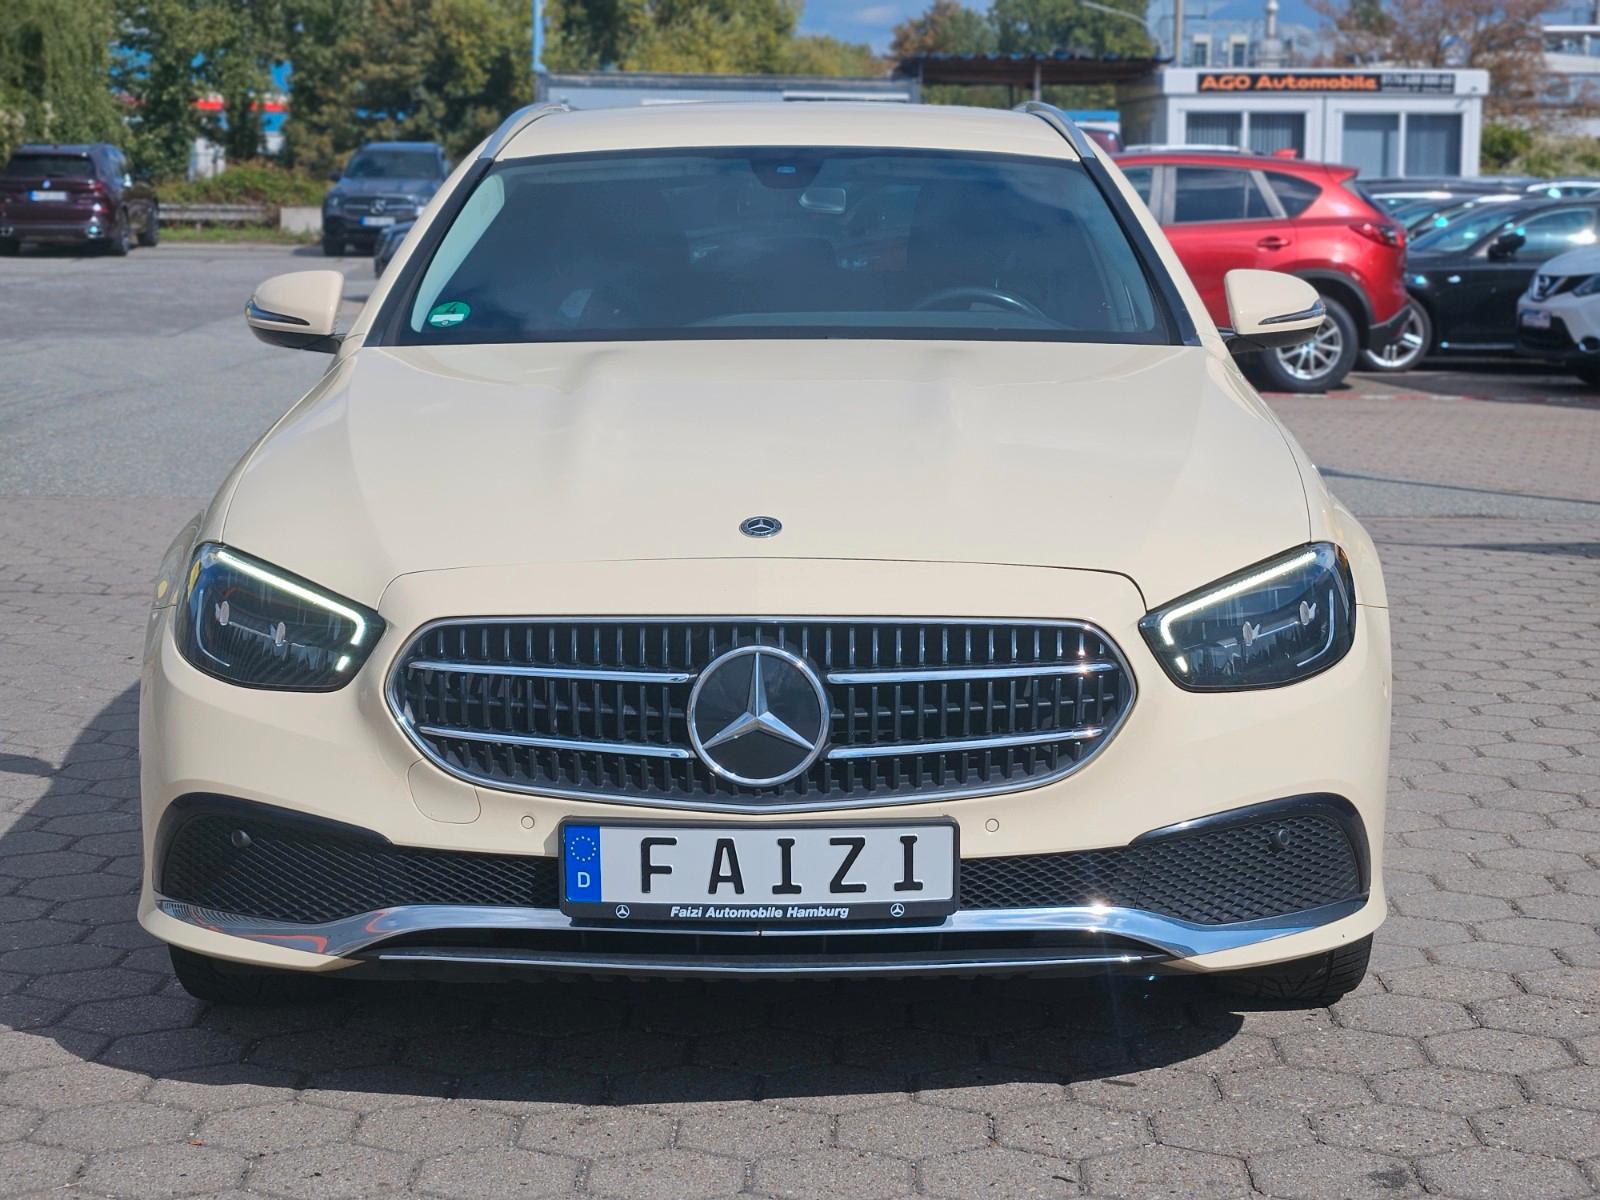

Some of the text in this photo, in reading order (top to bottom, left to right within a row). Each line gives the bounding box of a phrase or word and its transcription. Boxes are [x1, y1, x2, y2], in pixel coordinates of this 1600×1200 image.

[1201, 75, 1250, 90] AGO
[1255, 75, 1377, 90] Automobile
[577, 872, 591, 888] D
[670, 906, 850, 919] Faizi Automobile Hamburg
